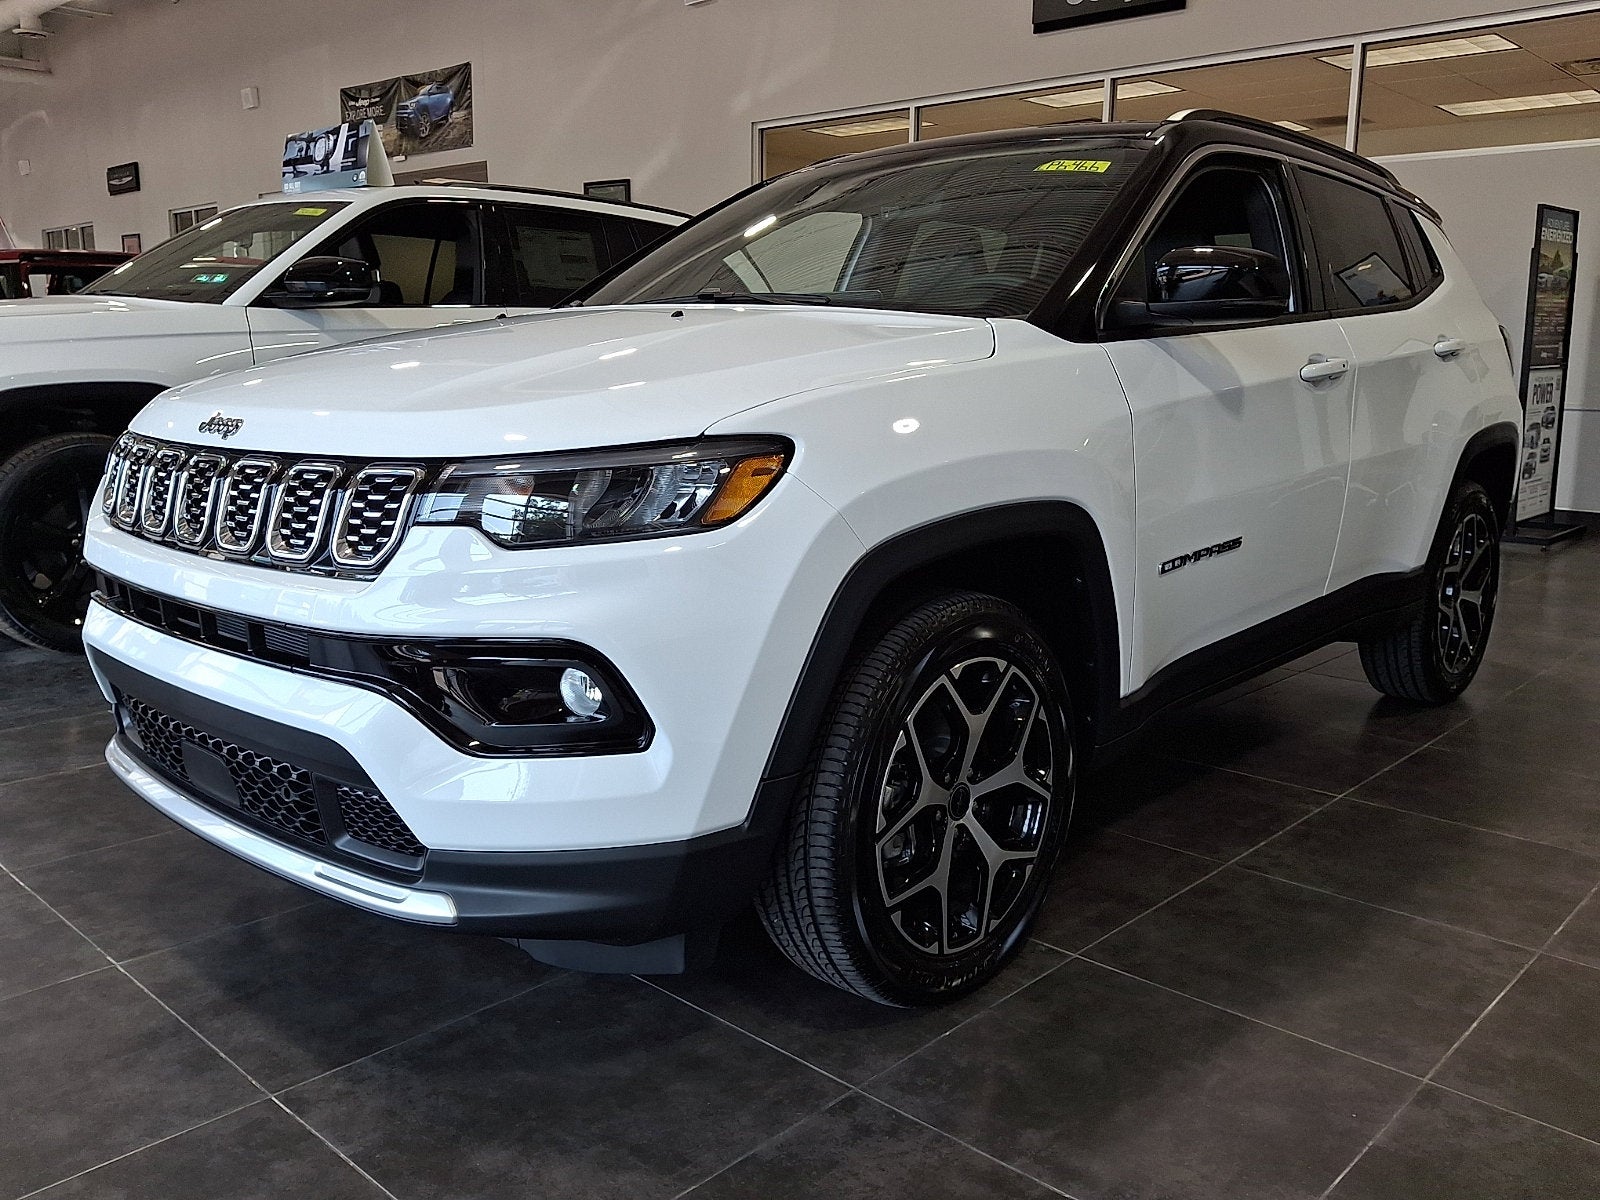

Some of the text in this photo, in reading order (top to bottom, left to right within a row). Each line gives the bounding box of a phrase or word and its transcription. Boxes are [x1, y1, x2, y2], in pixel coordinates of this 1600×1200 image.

[1541, 227, 1574, 244] ENERGIZED
[1532, 382, 1554, 405] POWER
[198, 411, 244, 440] Jeep
[1158, 535, 1243, 576] COMPASS
